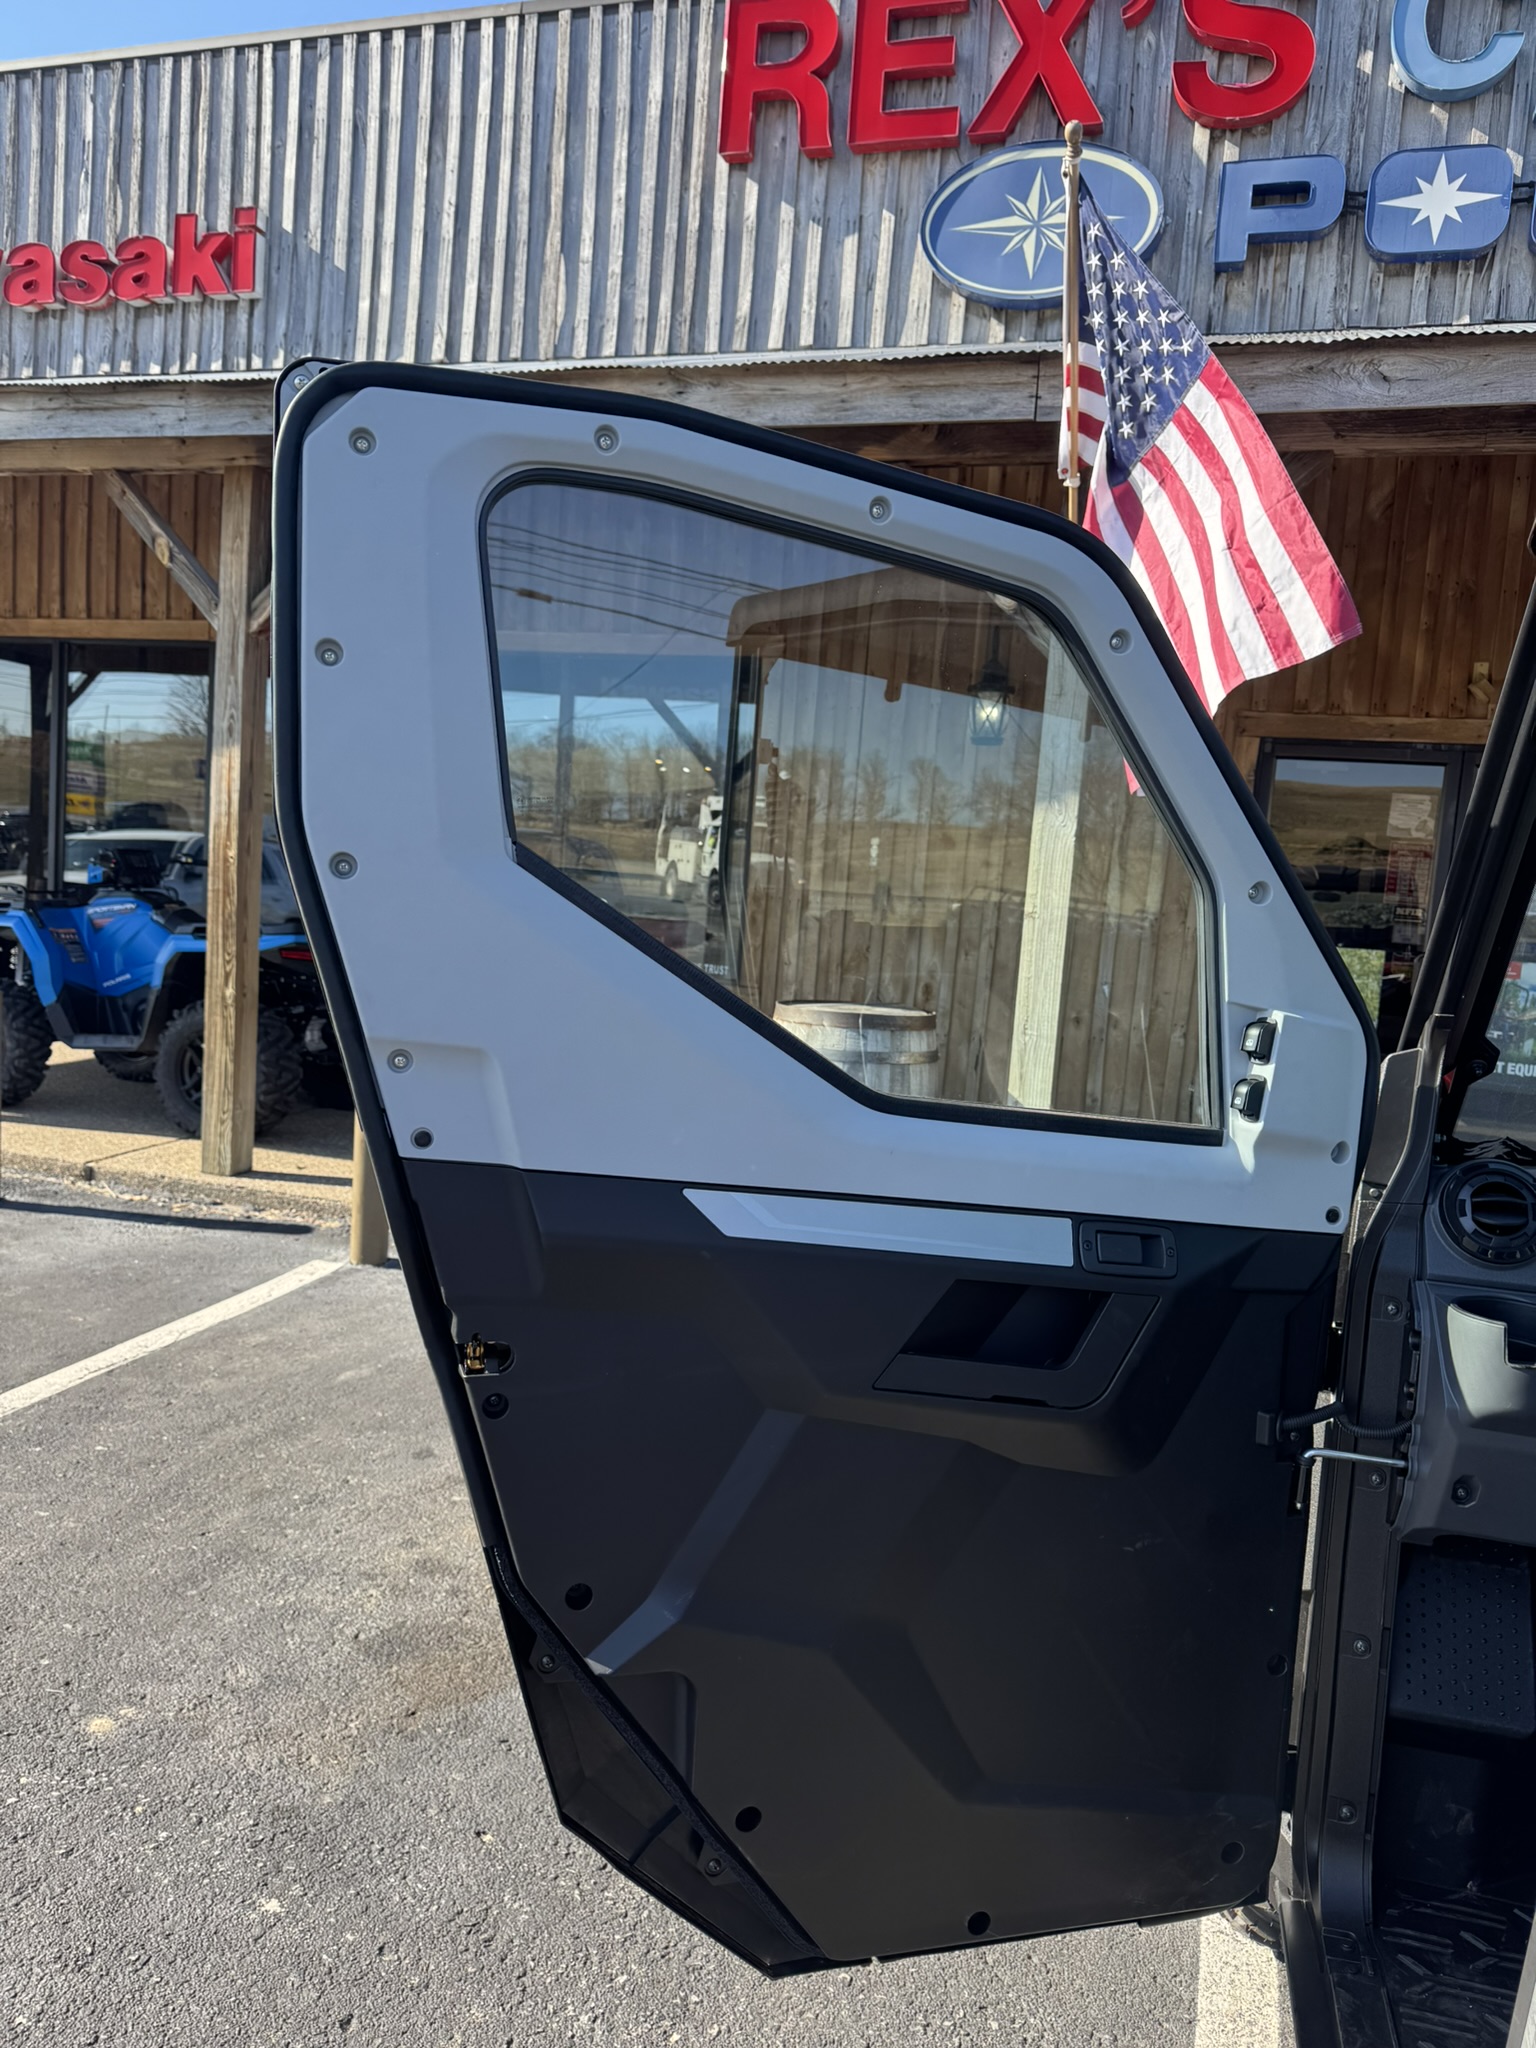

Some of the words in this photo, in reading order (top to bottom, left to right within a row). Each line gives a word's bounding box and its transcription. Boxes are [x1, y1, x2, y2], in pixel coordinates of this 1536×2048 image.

[717, 0, 1317, 163] REX'S
[1391, 0, 1530, 103] C
[0, 206, 261, 309] asaki
[1214, 144, 1536, 272] PO
[704, 963, 729, 976] TRUST
